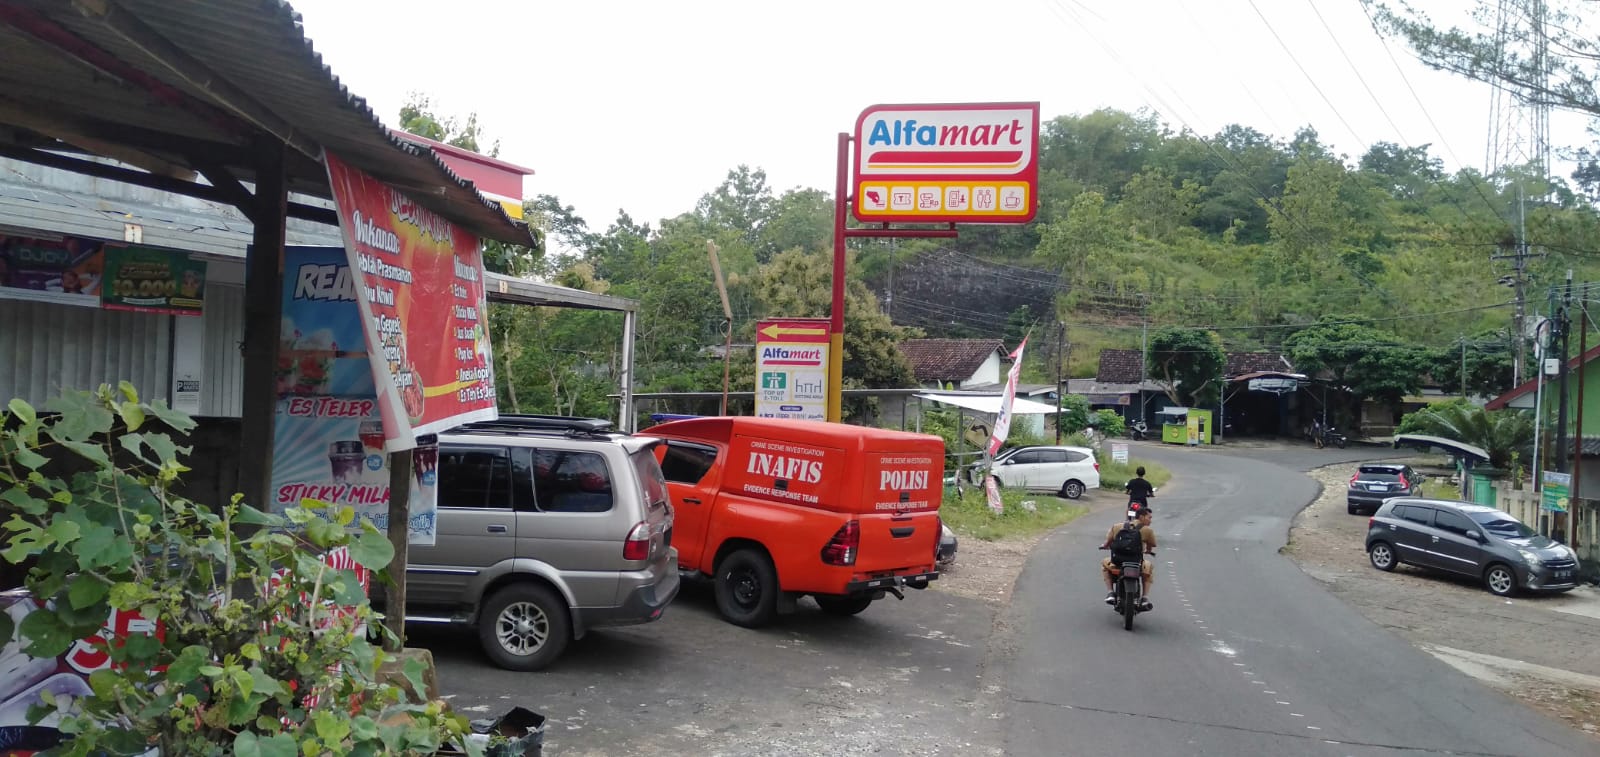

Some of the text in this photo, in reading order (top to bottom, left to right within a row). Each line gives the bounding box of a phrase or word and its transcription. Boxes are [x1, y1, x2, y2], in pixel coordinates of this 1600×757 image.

[868, 119, 1024, 146] Alfamart
[377, 258, 412, 284] Prasmanan
[294, 264, 356, 301] REA
[763, 347, 821, 360] Alfamart
[289, 397, 374, 417] ES TELER
[751, 441, 825, 457] CRIME SCENE INVESTIGATION
[747, 451, 823, 484] INAFIS
[880, 470, 929, 491] POLISI
[279, 485, 343, 504] STICKY
[744, 483, 819, 504] EVIDENCE RESPONSE TEAM
[875, 502, 897, 510] EVIDENCE
